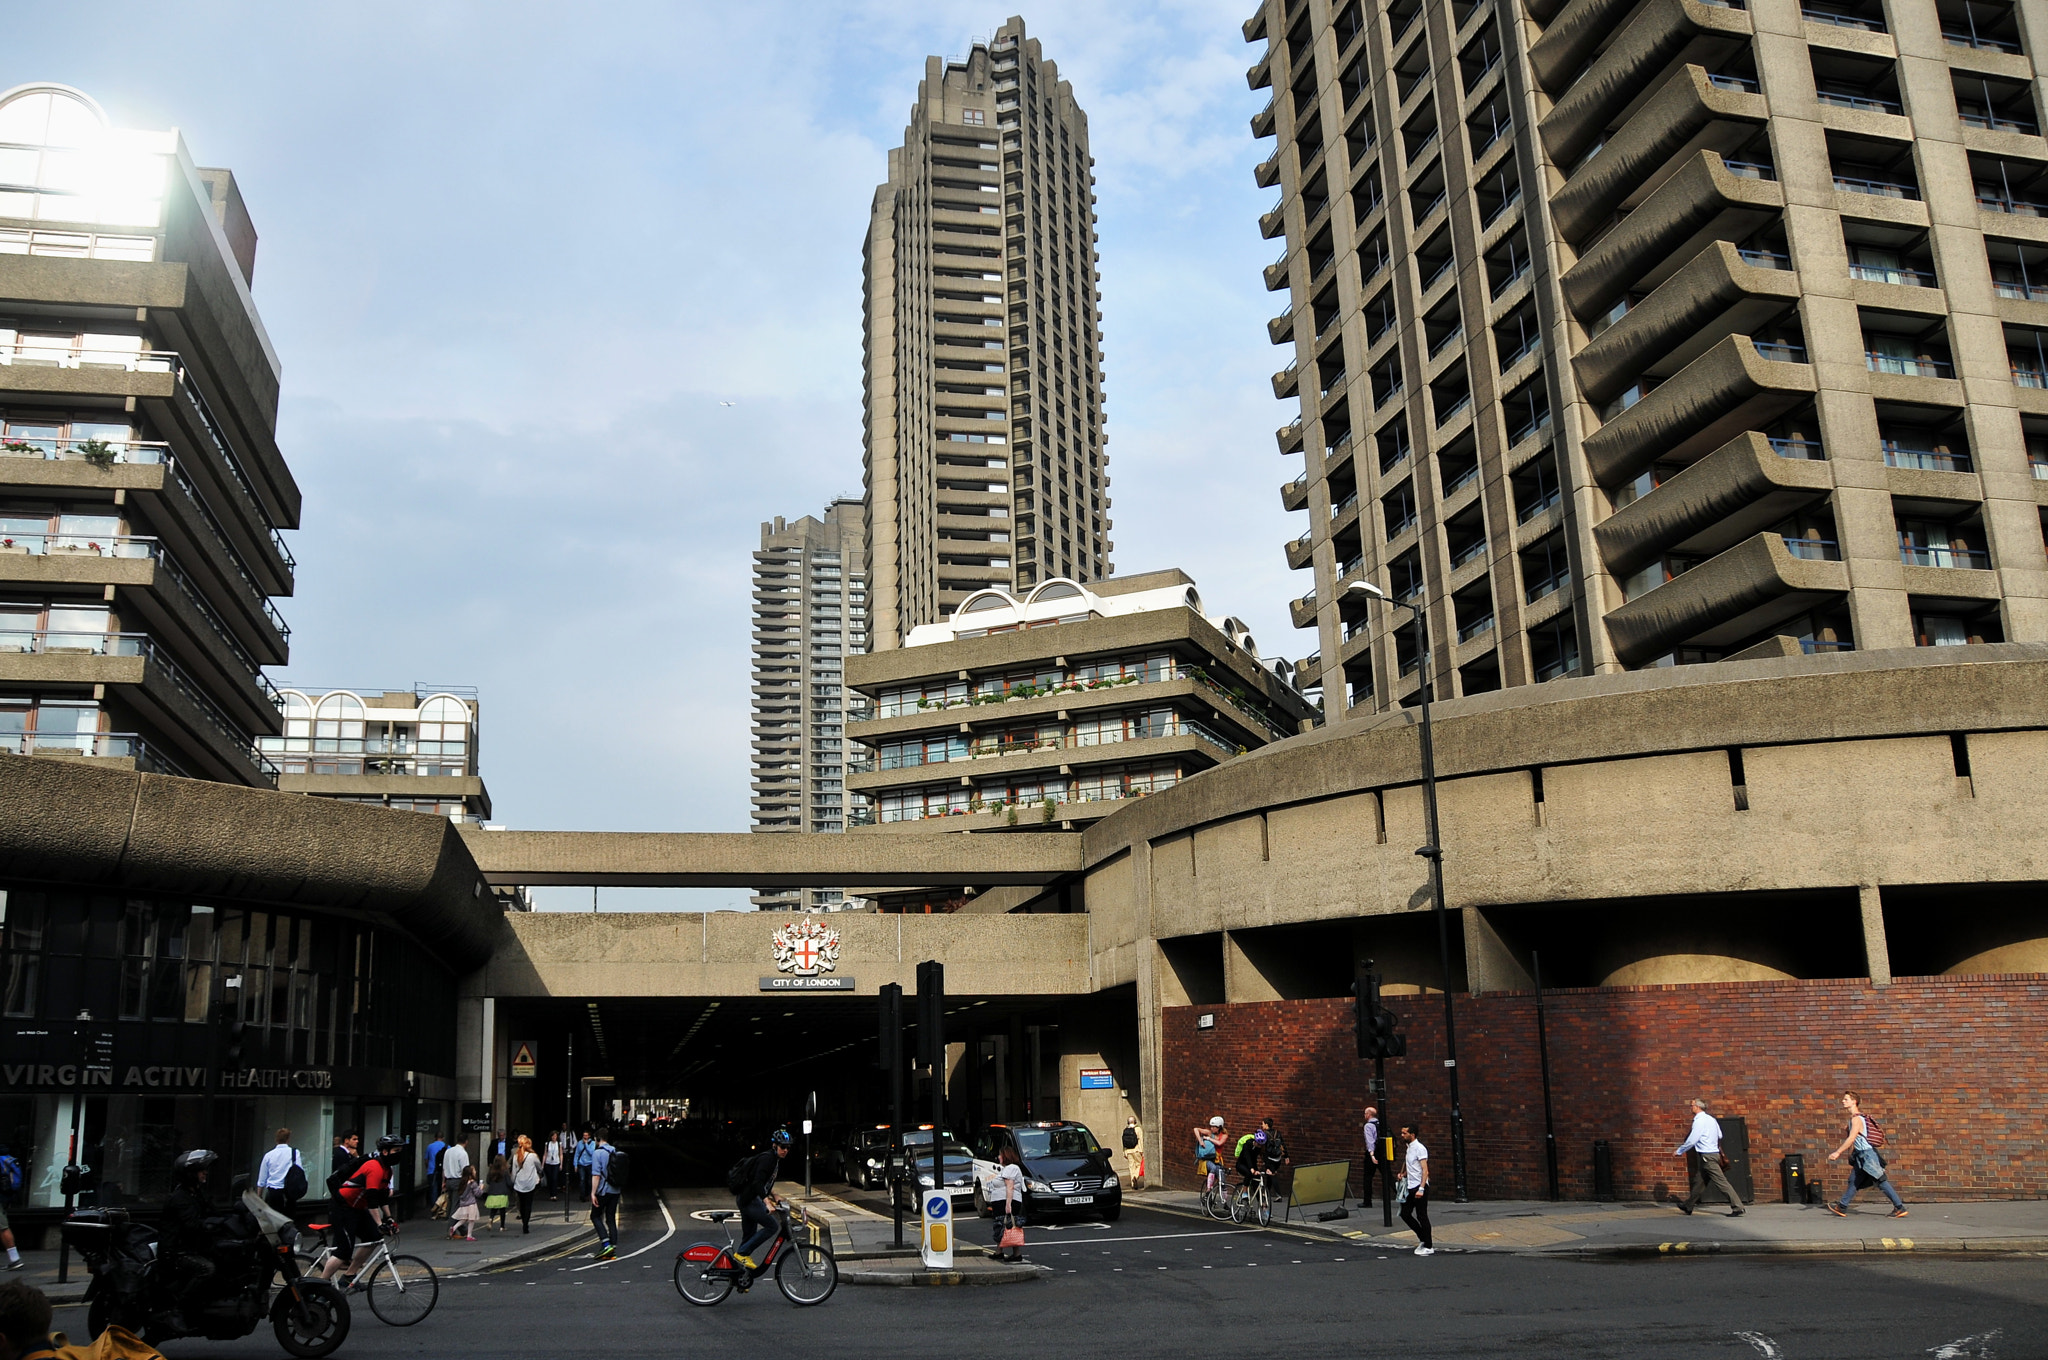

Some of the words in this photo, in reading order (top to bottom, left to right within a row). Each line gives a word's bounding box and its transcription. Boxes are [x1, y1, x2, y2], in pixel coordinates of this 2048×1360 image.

[772, 979, 790, 987] CITY
[793, 979, 804, 987] OF
[806, 979, 841, 987] LONDON
[2, 1064, 113, 1086] VIRGIN
[122, 1065, 207, 1087] ACTIV
[221, 1068, 289, 1089] HEALTH
[295, 1070, 332, 1089] CLUB
